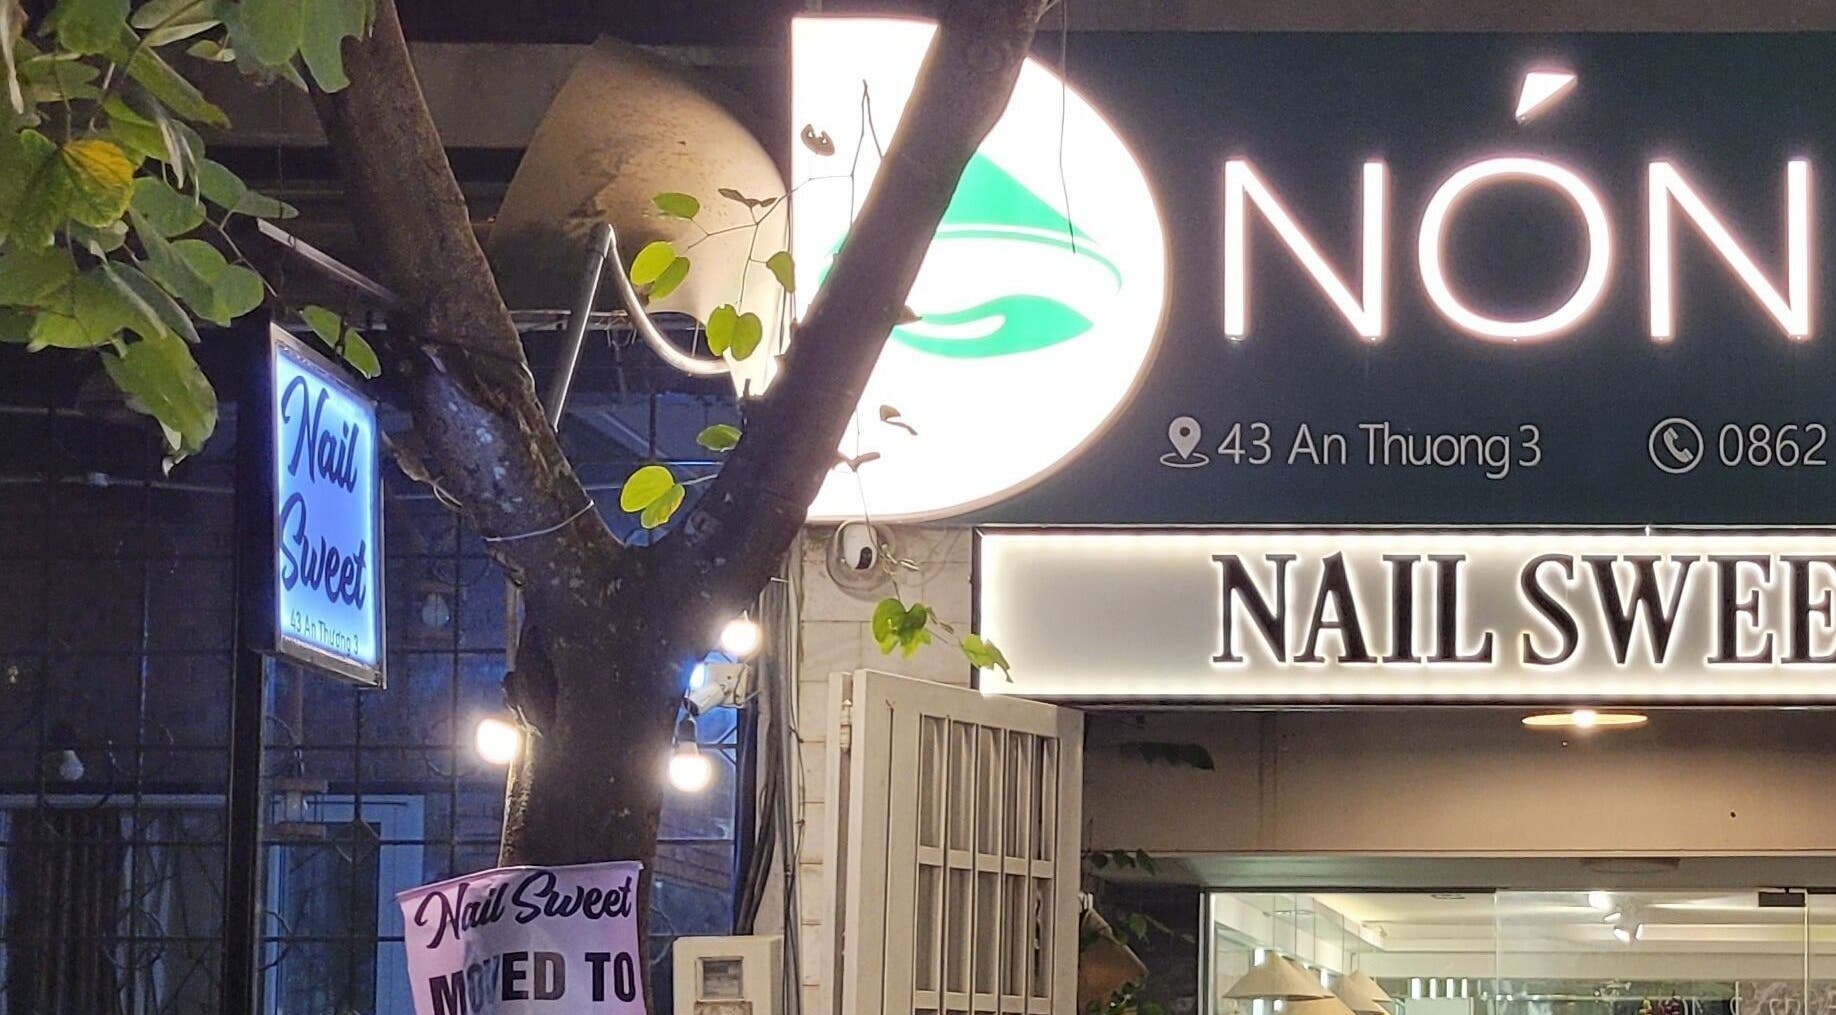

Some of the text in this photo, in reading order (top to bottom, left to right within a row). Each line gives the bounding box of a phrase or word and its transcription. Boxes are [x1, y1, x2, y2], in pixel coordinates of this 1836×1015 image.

[1222, 72, 1812, 342] NÓN
[283, 376, 360, 494] Nail
[1217, 422, 1272, 466] 43
[1288, 423, 1347, 466] An
[1718, 423, 1828, 467] 0862
[279, 492, 367, 611] Sweet
[290, 608, 302, 633] 43
[304, 615, 317, 640] An
[353, 634, 360, 656] 3
[1210, 550, 1496, 666] NAIL
[414, 870, 633, 949] Nail Sweet
[584, 952, 637, 1002] TO
